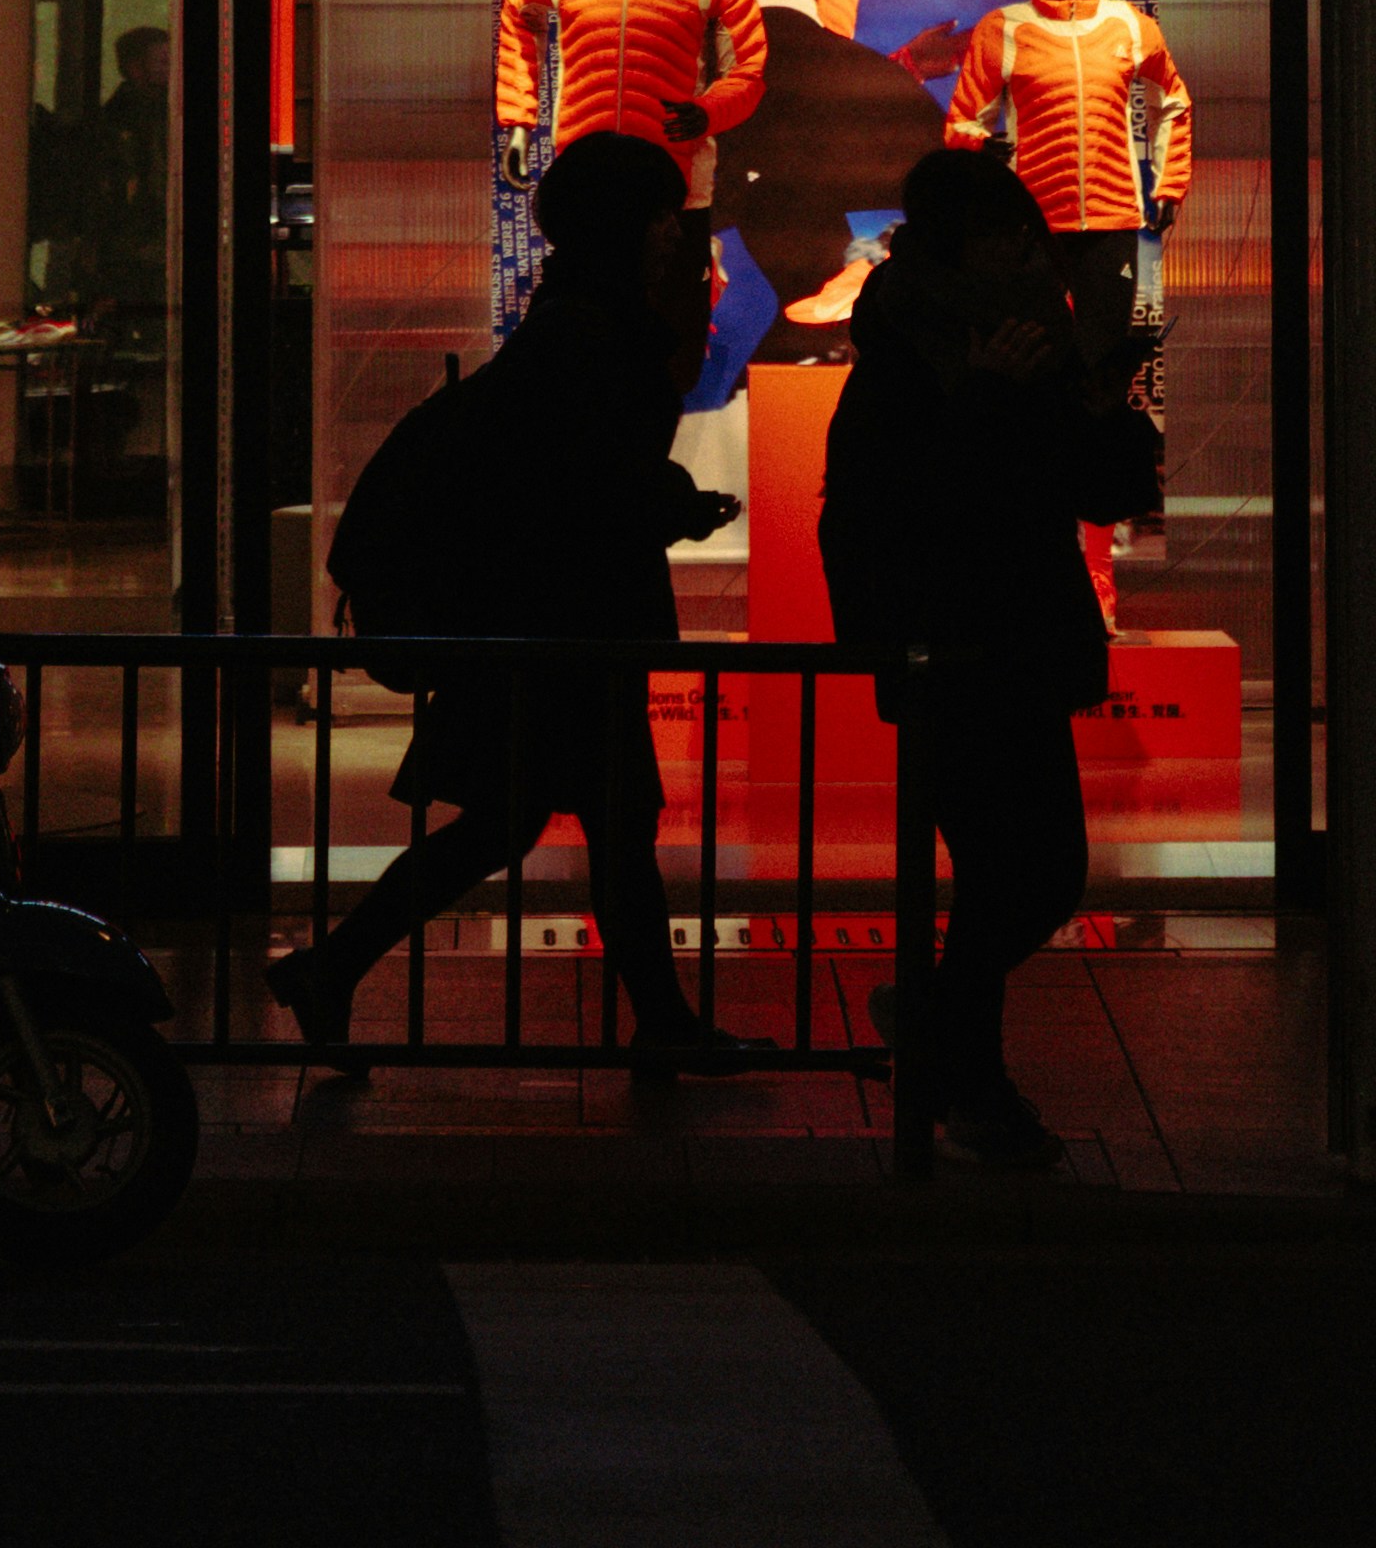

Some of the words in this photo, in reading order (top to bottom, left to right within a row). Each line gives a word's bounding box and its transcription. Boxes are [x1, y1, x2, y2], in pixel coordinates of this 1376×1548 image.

[499, 192, 513, 211] 26
[501, 220, 515, 258] WERE
[514, 194, 531, 278] MATERIALS
[503, 267, 517, 314] THERE
